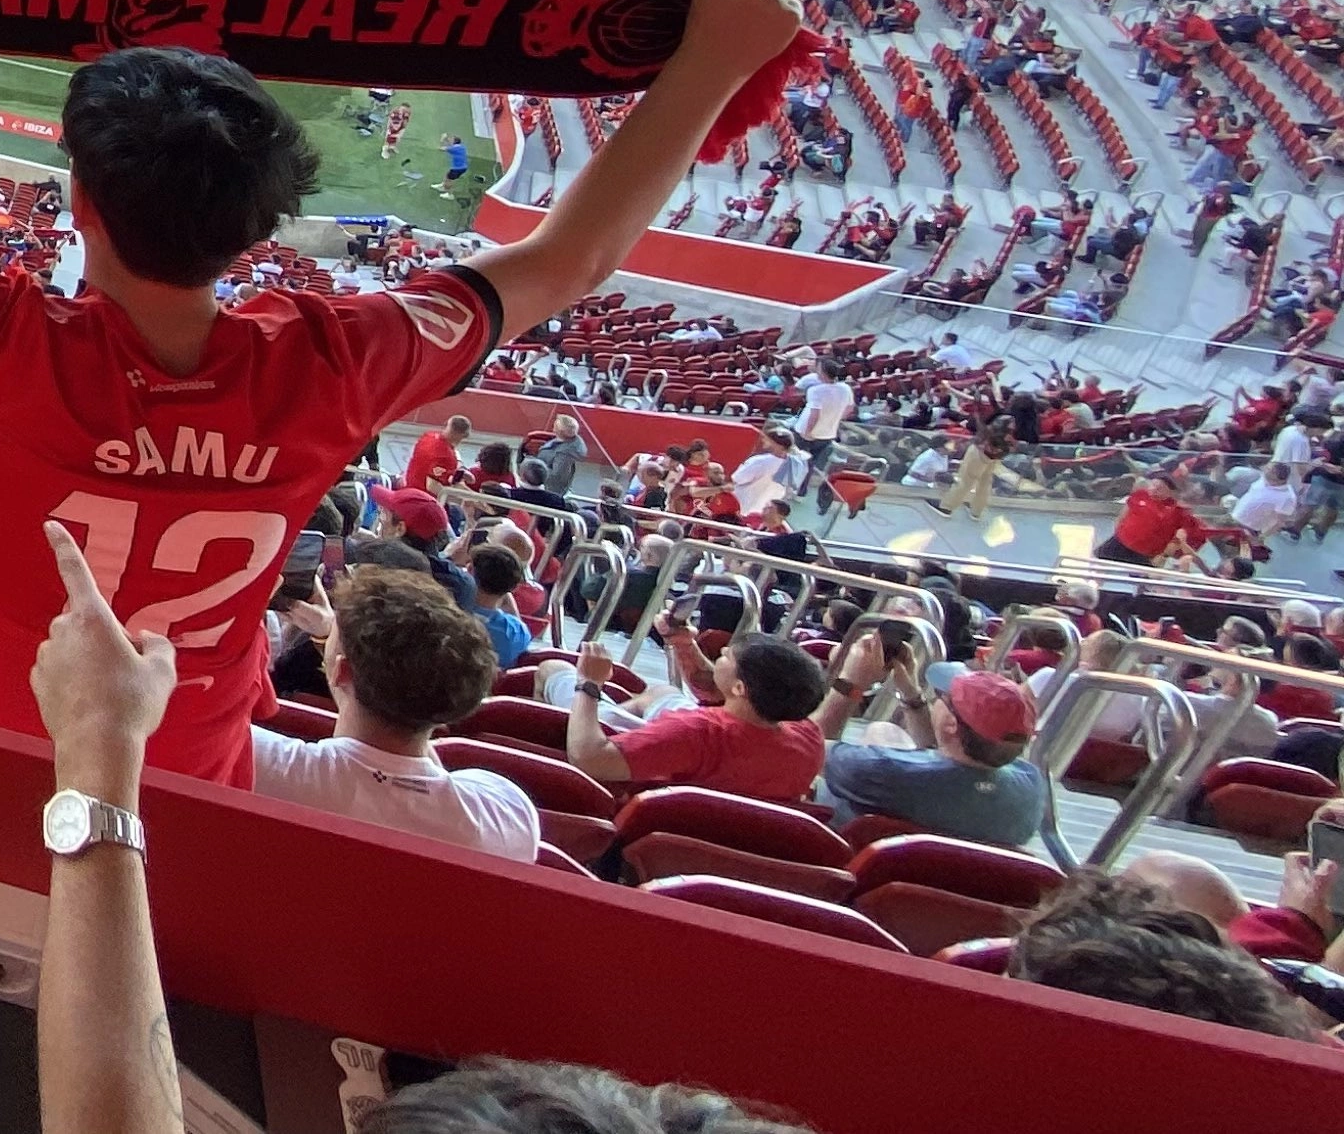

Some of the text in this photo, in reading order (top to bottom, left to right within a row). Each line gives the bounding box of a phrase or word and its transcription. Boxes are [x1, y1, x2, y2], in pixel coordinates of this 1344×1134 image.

[23, 122, 54, 137] IBIZA
[94, 425, 280, 484] SAMU
[48, 490, 288, 648] 12
